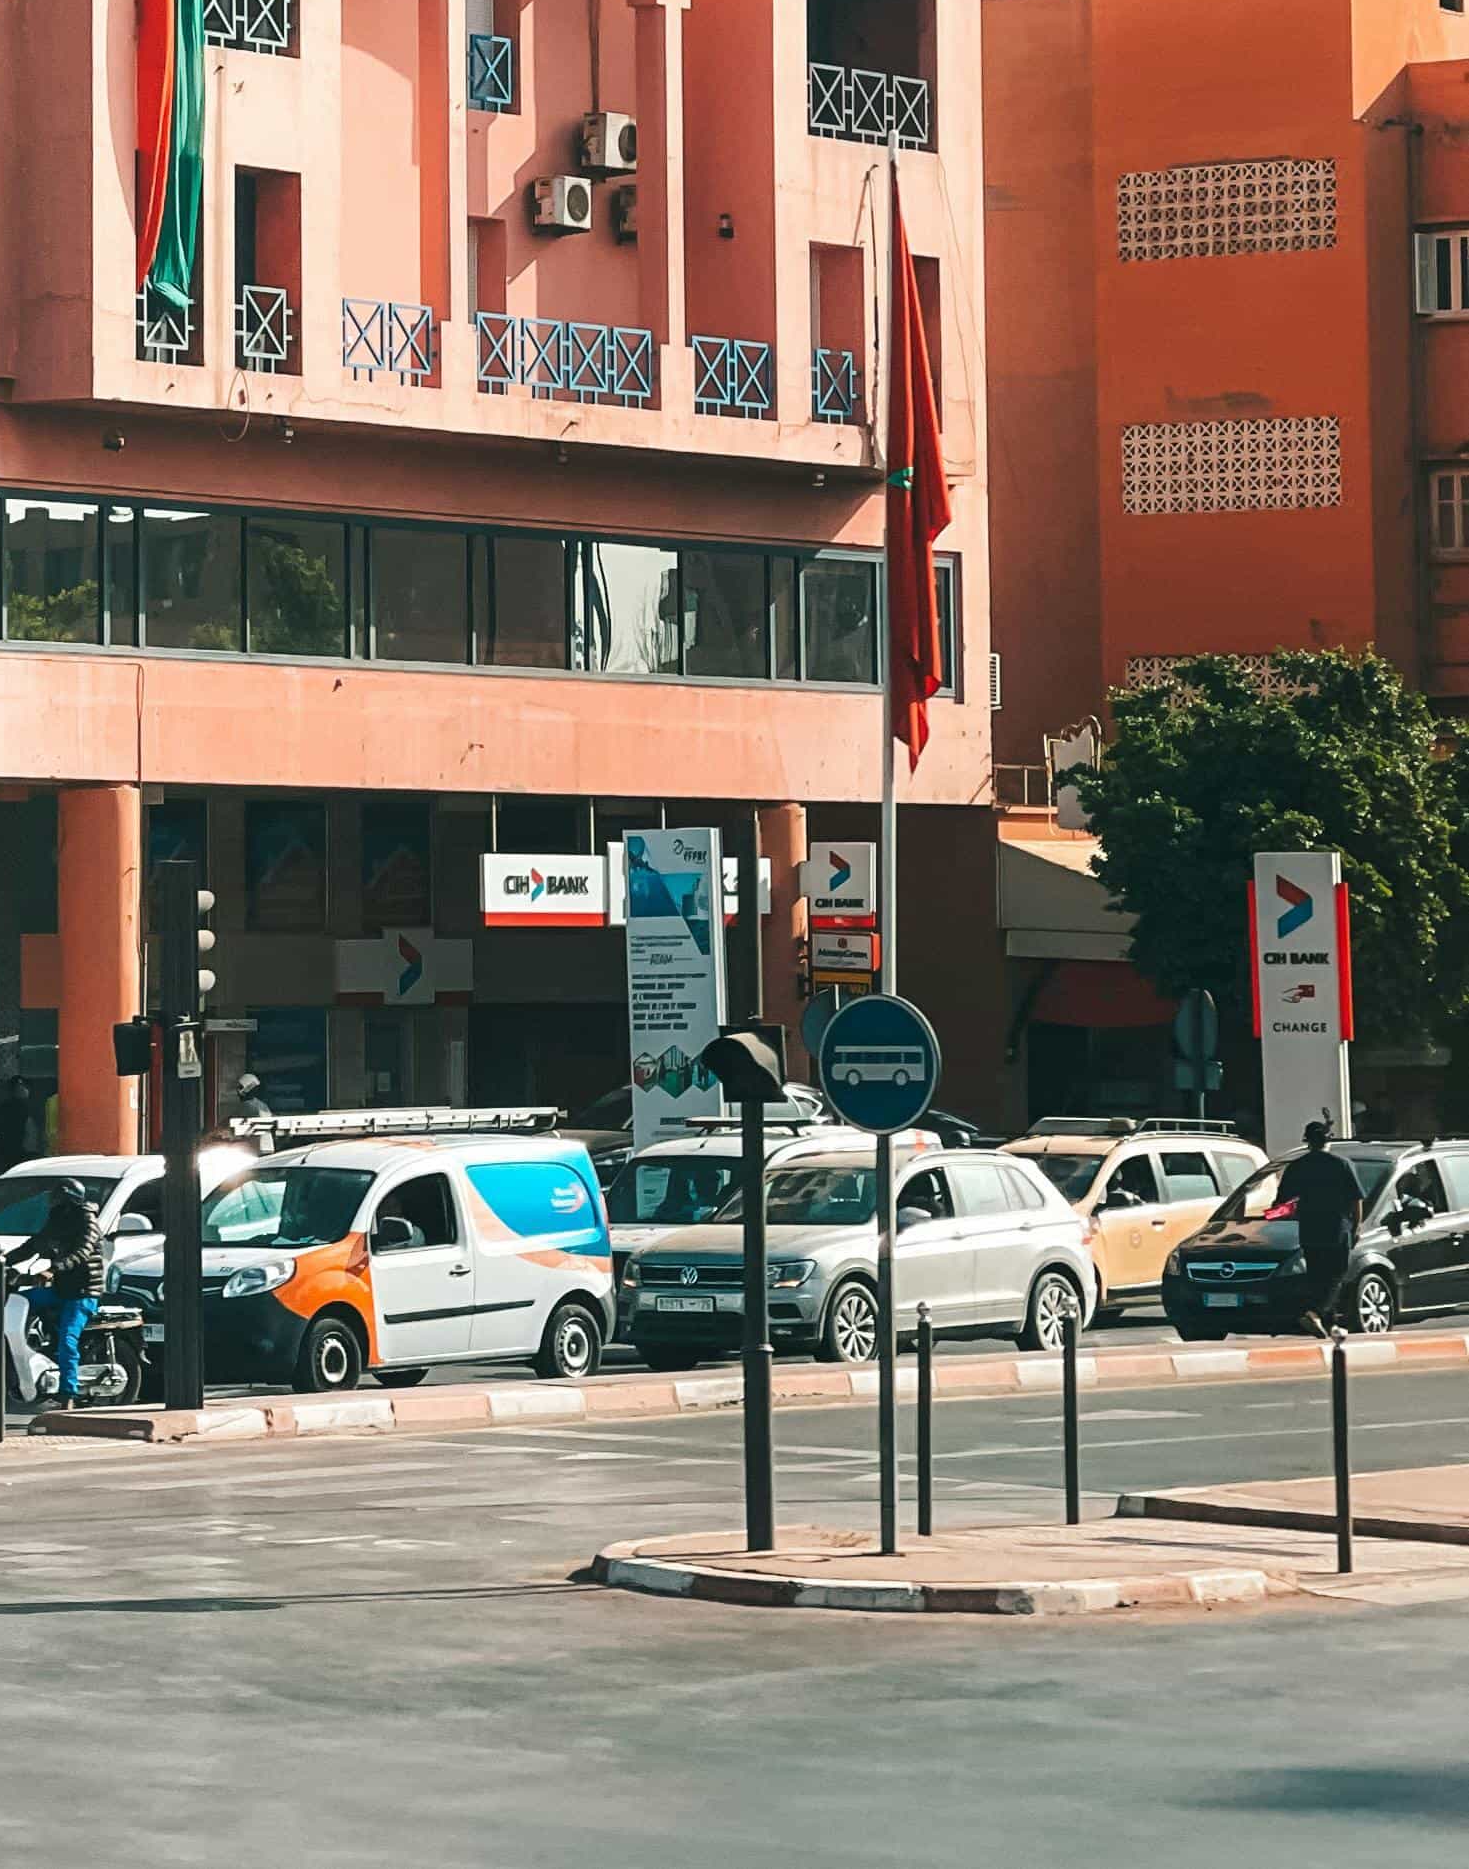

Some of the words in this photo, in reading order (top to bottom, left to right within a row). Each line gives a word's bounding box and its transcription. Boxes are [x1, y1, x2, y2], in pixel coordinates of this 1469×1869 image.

[503, 875, 530, 895] CIH
[546, 875, 589, 896] BANK
[815, 898, 832, 908] CIH
[834, 898, 864, 908] BANK
[1263, 952, 1287, 965] CIH
[1290, 952, 1331, 965] BANK
[1272, 1022, 1328, 1033] CHANGE
